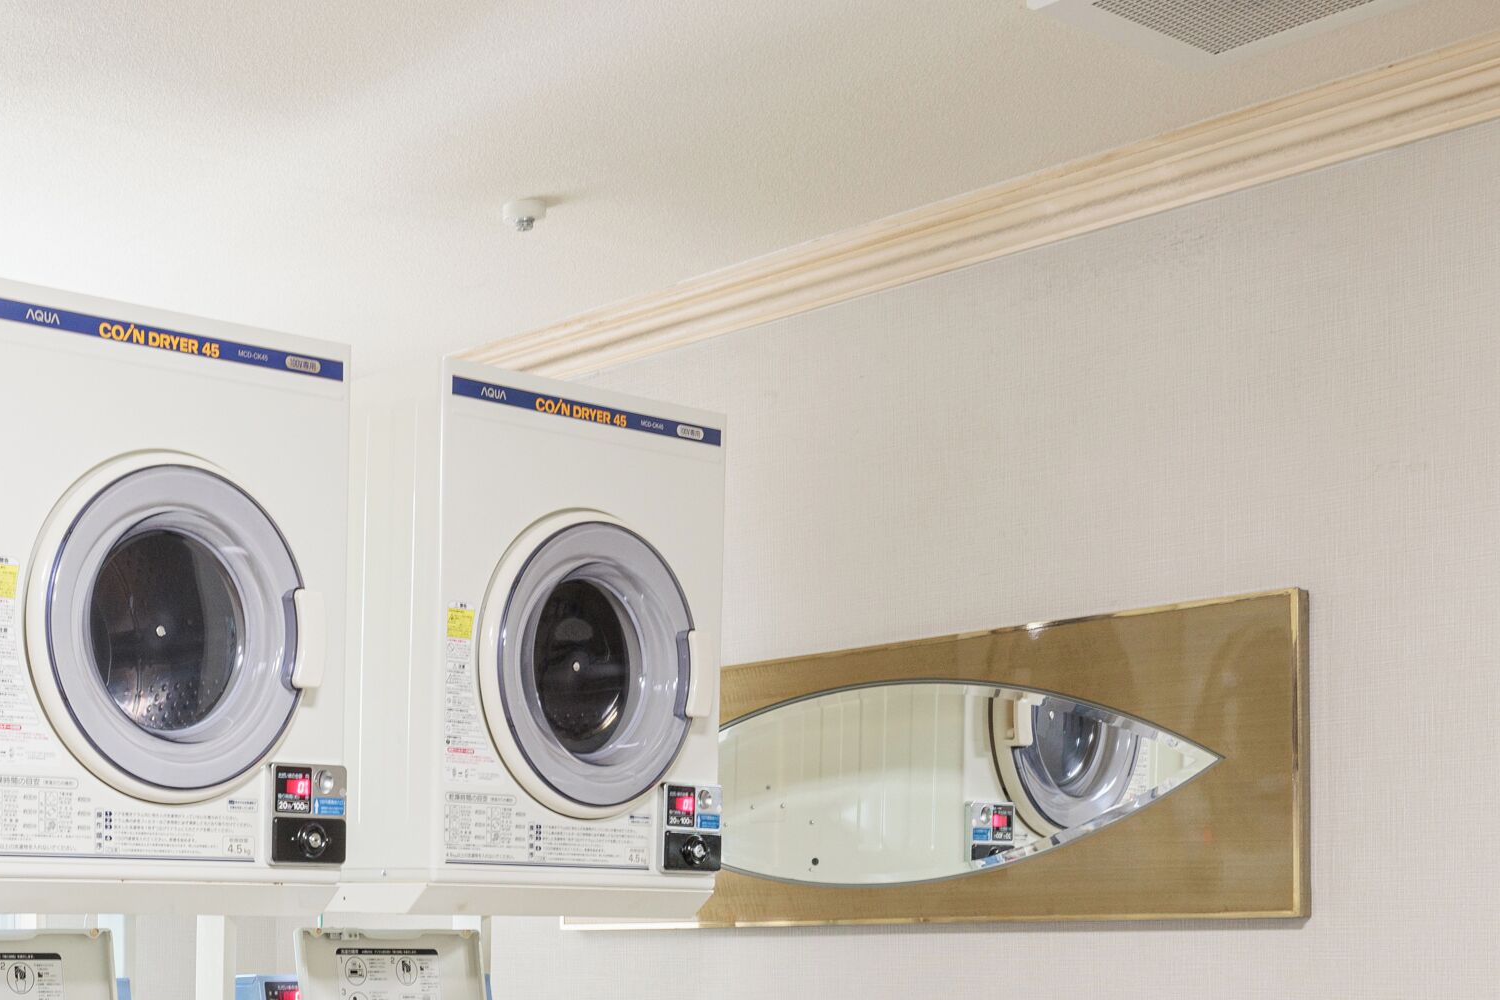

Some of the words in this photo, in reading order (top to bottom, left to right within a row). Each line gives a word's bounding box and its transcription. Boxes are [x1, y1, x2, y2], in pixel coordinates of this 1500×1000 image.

[25, 308, 60, 325] AQUA
[148, 331, 198, 354] DRYER
[201, 342, 220, 359] 45
[481, 386, 507, 400] AQUA
[572, 405, 611, 424] DRYER
[613, 415, 627, 428] 45
[297, 781, 305, 793] 0
